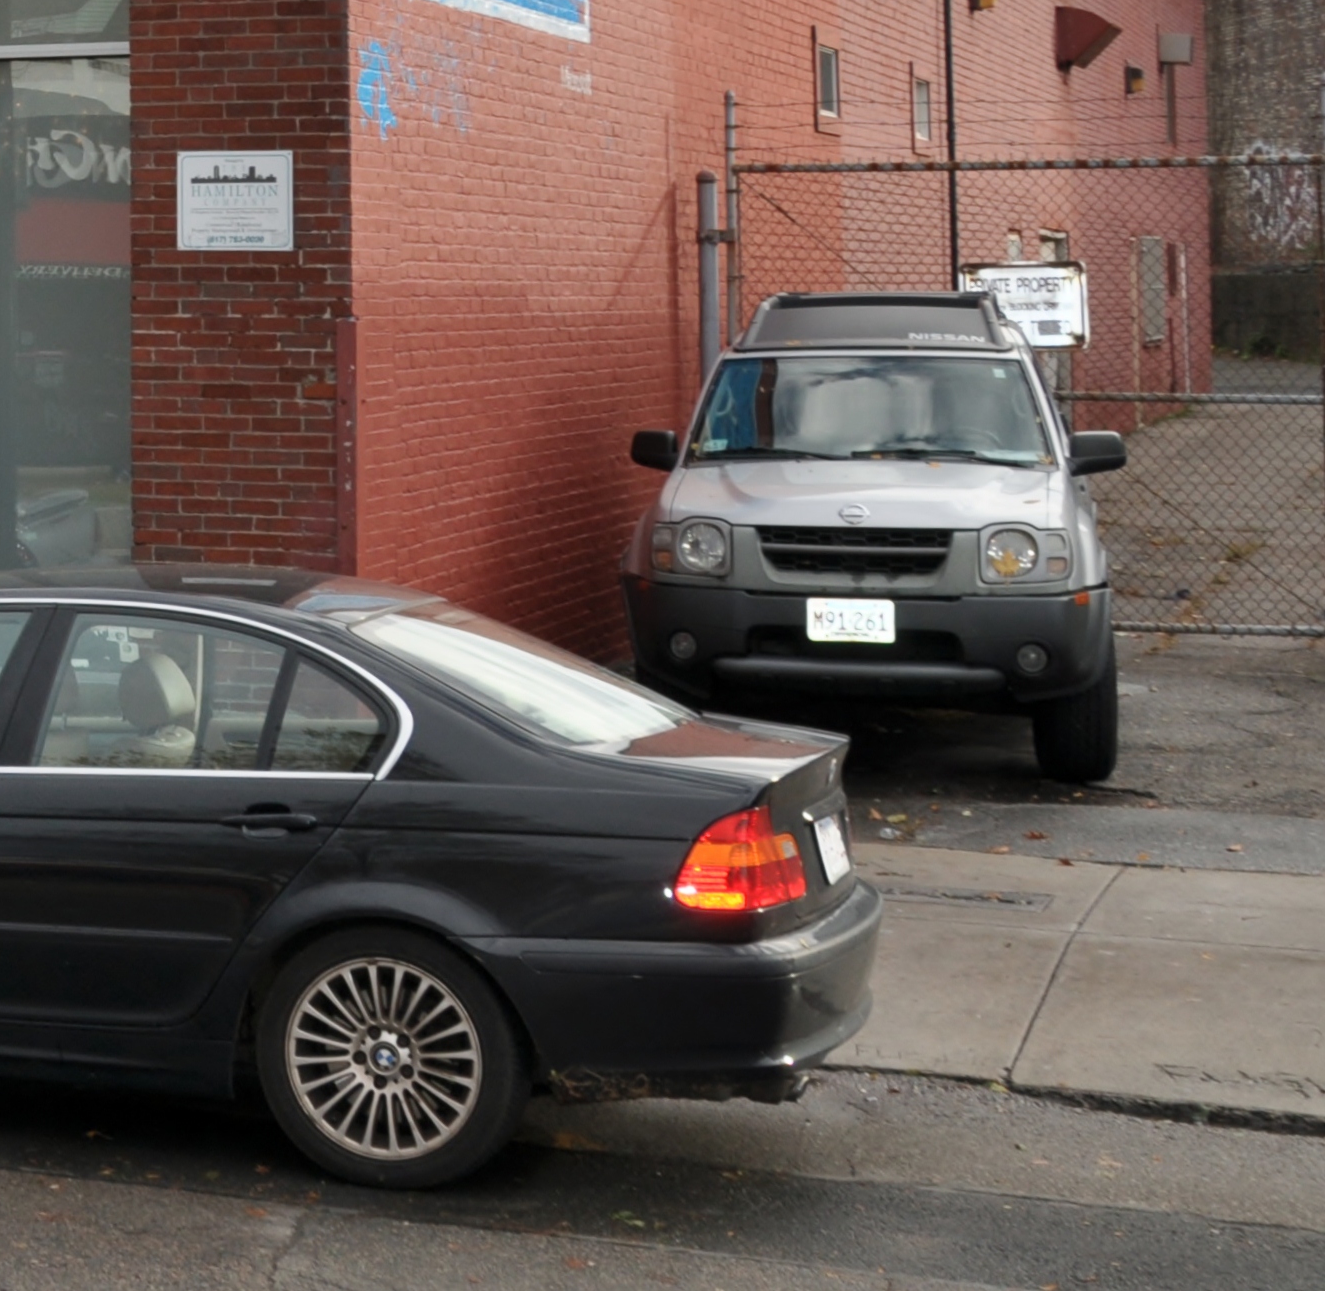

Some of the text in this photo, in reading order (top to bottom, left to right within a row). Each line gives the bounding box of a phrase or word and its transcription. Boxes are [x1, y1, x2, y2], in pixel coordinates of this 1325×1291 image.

[191, 184, 279, 198] HAMILTON
[204, 198, 266, 206] COMPANY
[969, 276, 1075, 294] PRIVATE PROPERTY
[908, 332, 985, 343] NISSAN
